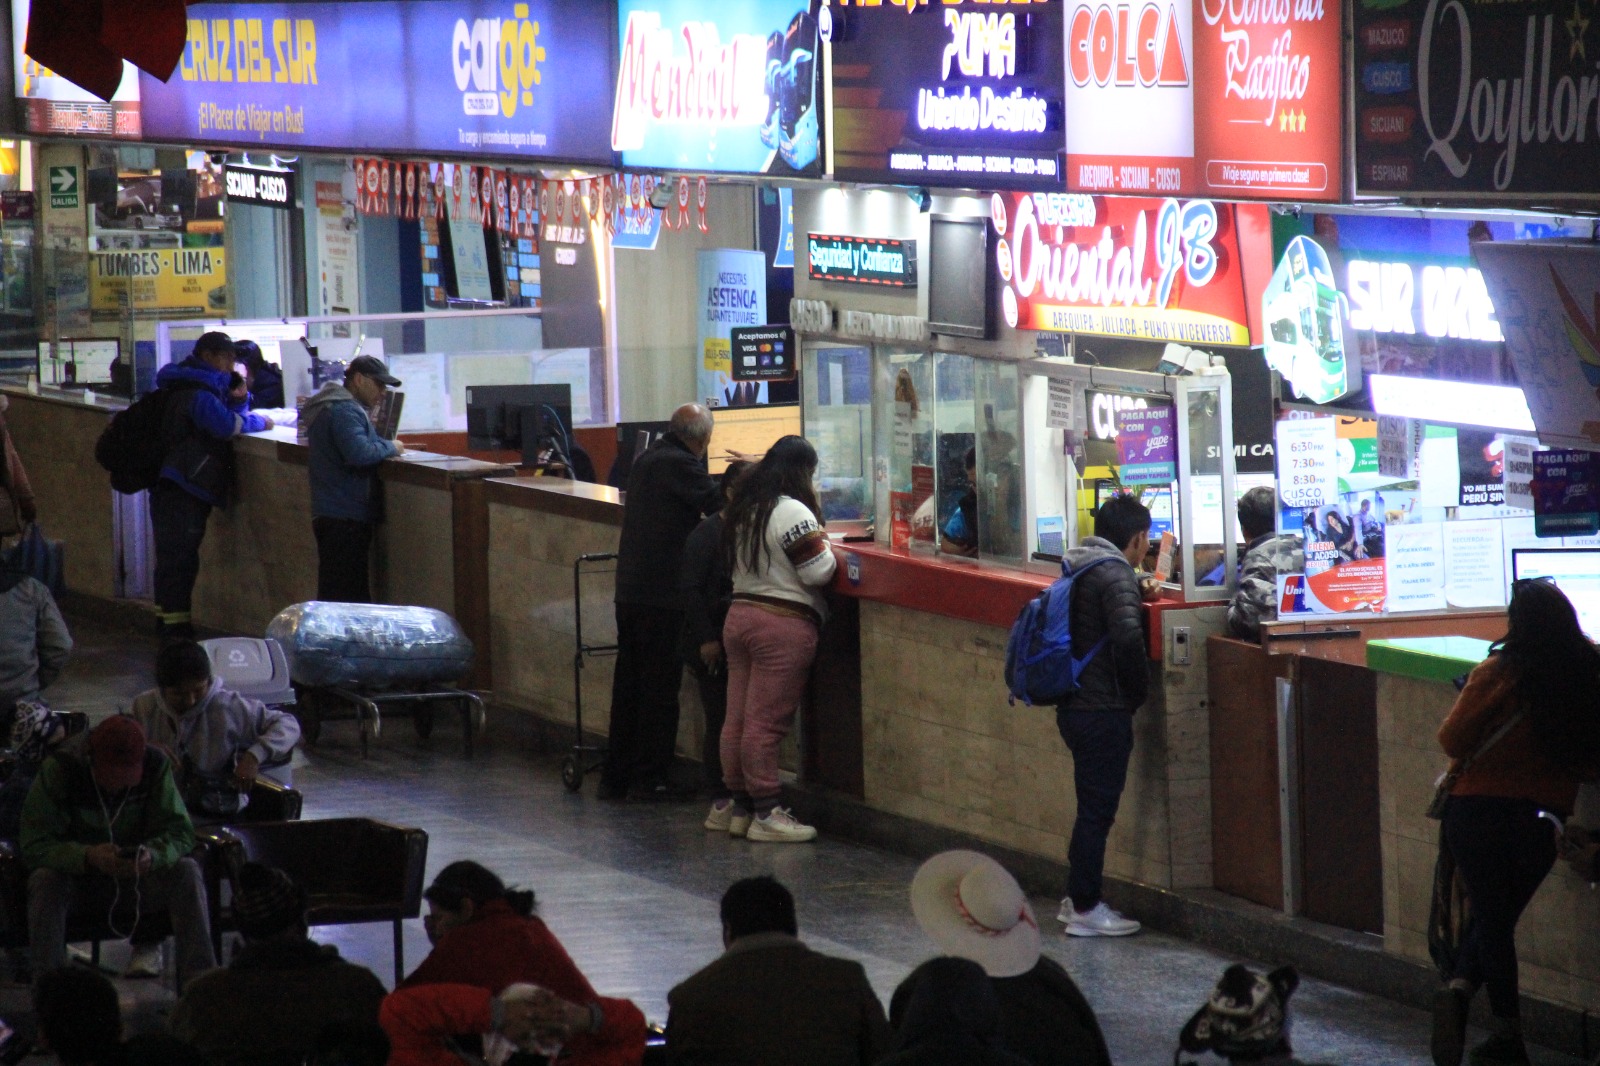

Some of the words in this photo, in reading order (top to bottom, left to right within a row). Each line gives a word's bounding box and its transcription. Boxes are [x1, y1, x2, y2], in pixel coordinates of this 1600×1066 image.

[942, 8, 1016, 81] PUMA
[1069, 3, 1189, 88] COLCA
[1368, 28, 1405, 45] MAZUCO
[180, 19, 233, 82] CRUZ
[234, 18, 272, 82] DEL
[272, 18, 318, 85] SUR
[452, 17, 536, 118] cargo
[1372, 70, 1402, 86] CUSCO
[917, 86, 980, 132] Uniendo
[980, 86, 1047, 133] Destinos
[209, 102, 233, 131] Placer
[235, 103, 246, 131] de
[247, 103, 271, 140] Viajar
[273, 110, 284, 133] en
[285, 104, 305, 134] Bus!
[1370, 116, 1404, 132] SICUANI
[458, 128, 465, 145] Tu
[466, 132, 478, 148] carga
[483, 129, 510, 145] encomienda
[511, 132, 526, 149] segura
[531, 128, 547, 149] tiempo
[1079, 165, 1114, 190] AREQUIPA
[1120, 166, 1150, 190] SICUANI
[1156, 167, 1181, 191] CUSCO
[1240, 168, 1260, 184] seguro
[1260, 169, 1268, 182] en
[1268, 166, 1292, 186] primera
[1372, 165, 1408, 181] ESPINAR
[259, 174, 287, 203] CUSCO
[51, 196, 78, 206] SALIDA
[810, 240, 853, 273] Seguridad
[853, 249, 860, 276] y
[860, 243, 904, 274] Confianza
[1013, 195, 1152, 307] Oriental
[96, 251, 160, 277] TUMBES
[173, 250, 213, 275] LIMA
[707, 287, 758, 310] ASISTENCIA
[1348, 260, 1415, 334] SUR
[707, 309, 731, 322] DURANTE
[790, 298, 832, 333] CUSCO
[738, 332, 779, 341] Aceptamos
[1053, 311, 1094, 333] AREQUIPA
[1101, 315, 1137, 336] JULIACA
[1143, 318, 1169, 340] PUNO
[1171, 324, 1176, 340] Y
[1178, 322, 1232, 343] VICEVERSA
[742, 344, 757, 352] VISA
[1120, 410, 1145, 421] PAGA
[1146, 408, 1168, 420] AQUÍ
[1126, 423, 1144, 432] CON
[1144, 435, 1169, 456] yape
[1538, 455, 1563, 464] PAGA
[1127, 466, 1147, 475] AHORA
[1149, 465, 1169, 473] TODOS
[1283, 487, 1322, 500] CUSCO
[1463, 485, 1475, 493] YO
[1475, 484, 1486, 492] ME
[1463, 492, 1487, 504] PERÚ
[1308, 541, 1335, 552] FRENA
[1314, 550, 1339, 561] ACOSO
